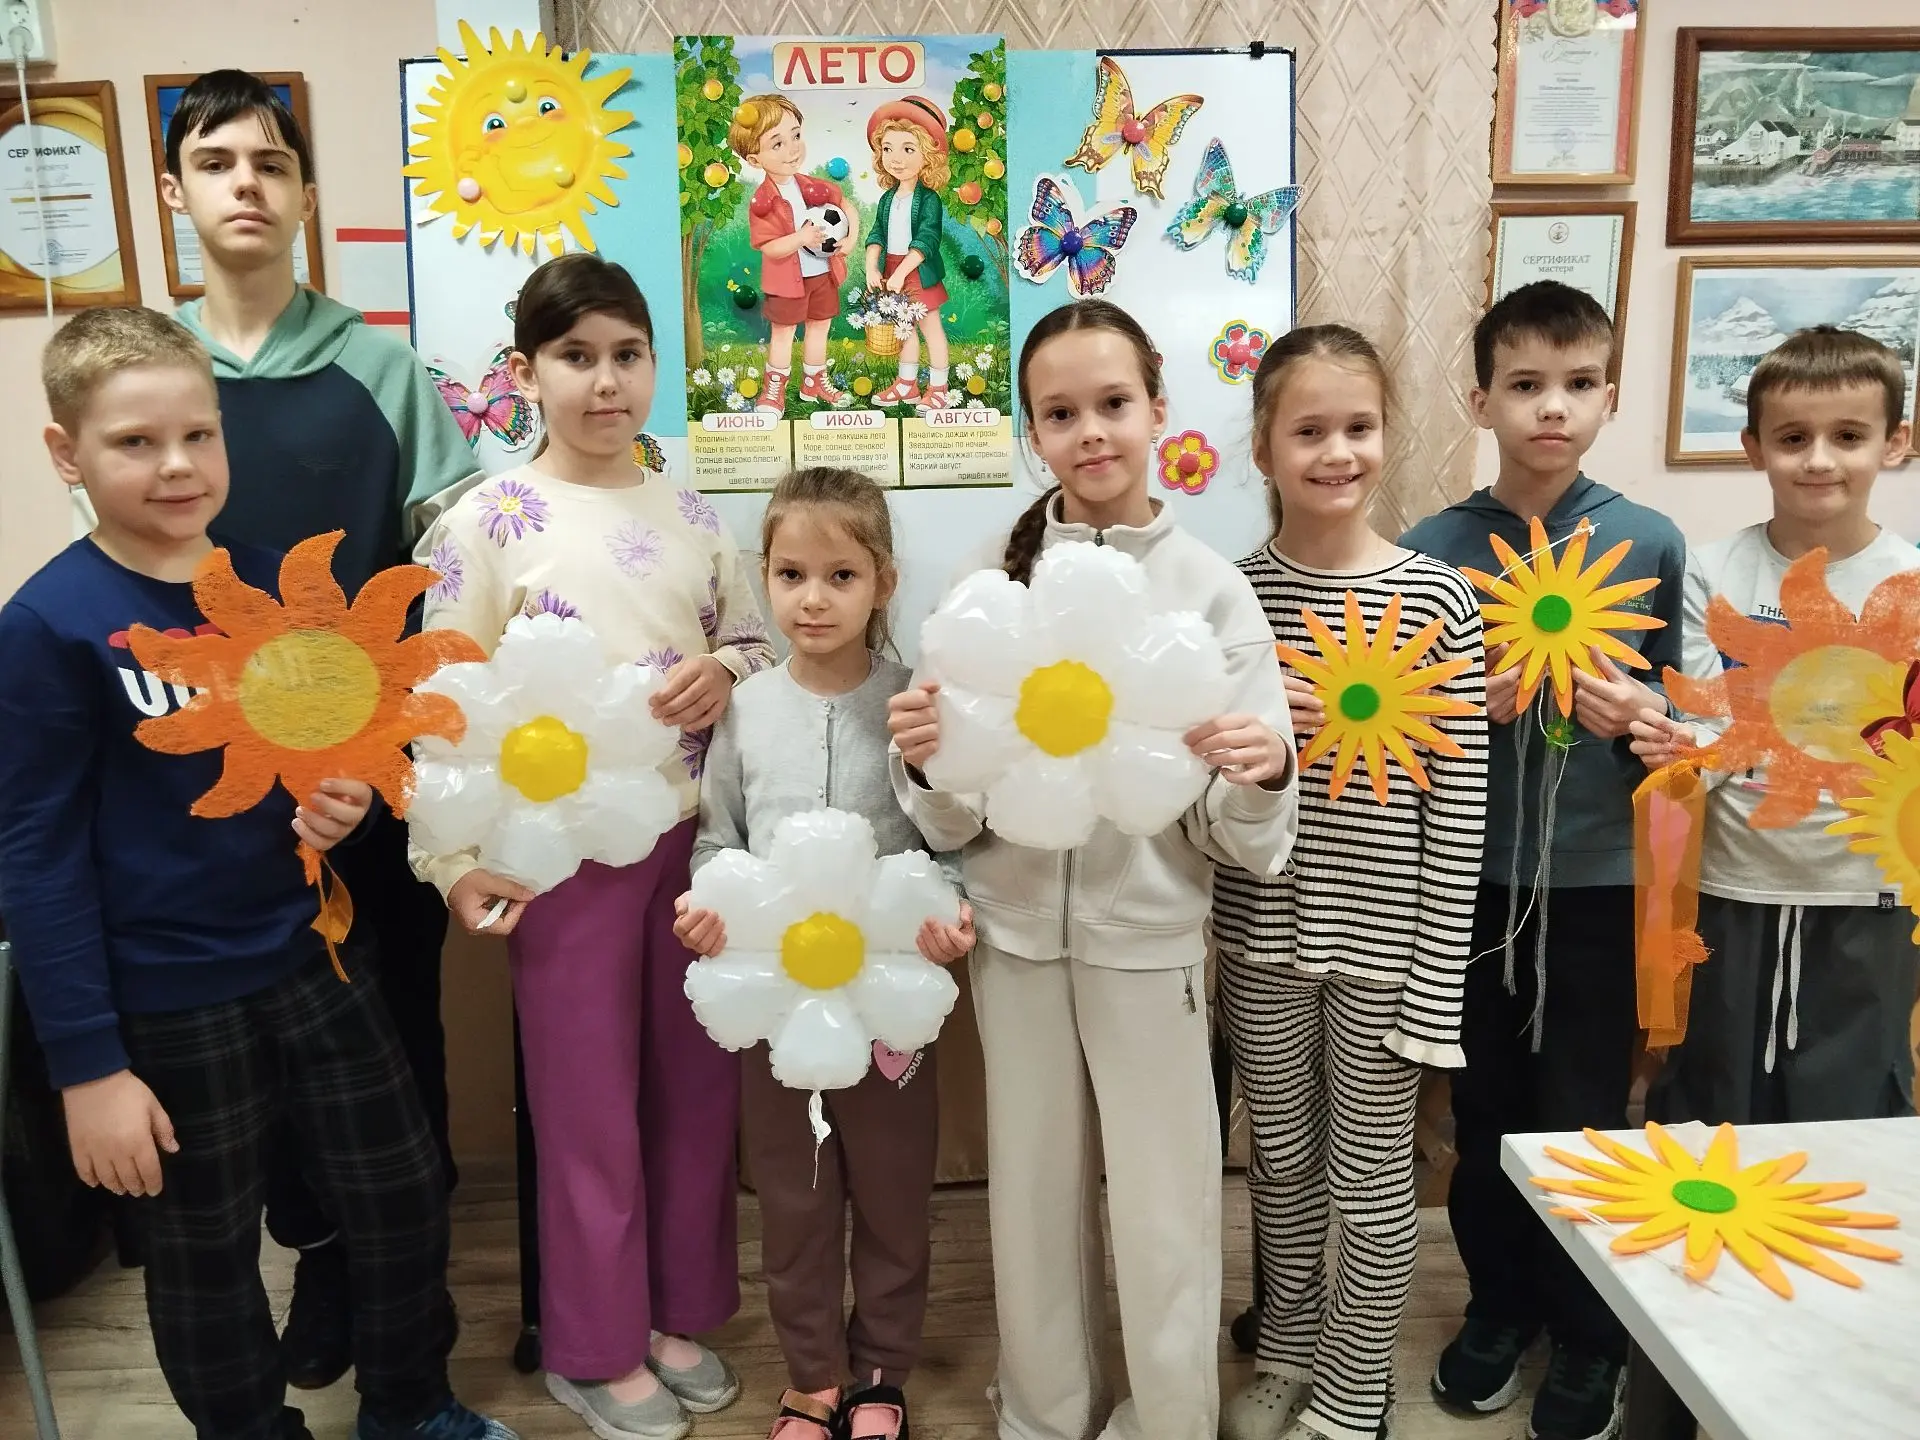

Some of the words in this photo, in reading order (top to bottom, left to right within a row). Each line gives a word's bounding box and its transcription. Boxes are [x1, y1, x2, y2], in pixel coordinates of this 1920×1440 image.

[783, 45, 916, 85] ЛЕТО
[7, 145, 81, 159] СЕРИФИКАТ
[1522, 254, 1592, 265] СЕРТИФИКАТ
[1538, 265, 1574, 275] мастера
[716, 415, 765, 429] ИЮНЬ
[825, 413, 873, 426] ИЮЛЬ
[933, 411, 992, 424] АВГУСТ
[836, 433, 868, 442] макушка
[908, 431, 944, 439] Начались
[908, 441, 953, 449] Звездопады
[694, 446, 718, 454] Ягоды
[726, 446, 742, 454] лесу
[695, 456, 723, 464] Солнце
[724, 456, 752, 464] высоко
[803, 454, 822, 462] Всем
[852, 454, 873, 462] нраву
[909, 452, 923, 460] Над
[923, 451, 945, 460] рекой
[696, 467, 701, 475] В
[909, 462, 938, 471] Жаркий
[939, 462, 962, 470] август
[957, 472, 985, 480] пришёл
[897, 1051, 925, 1090] AMOUR
